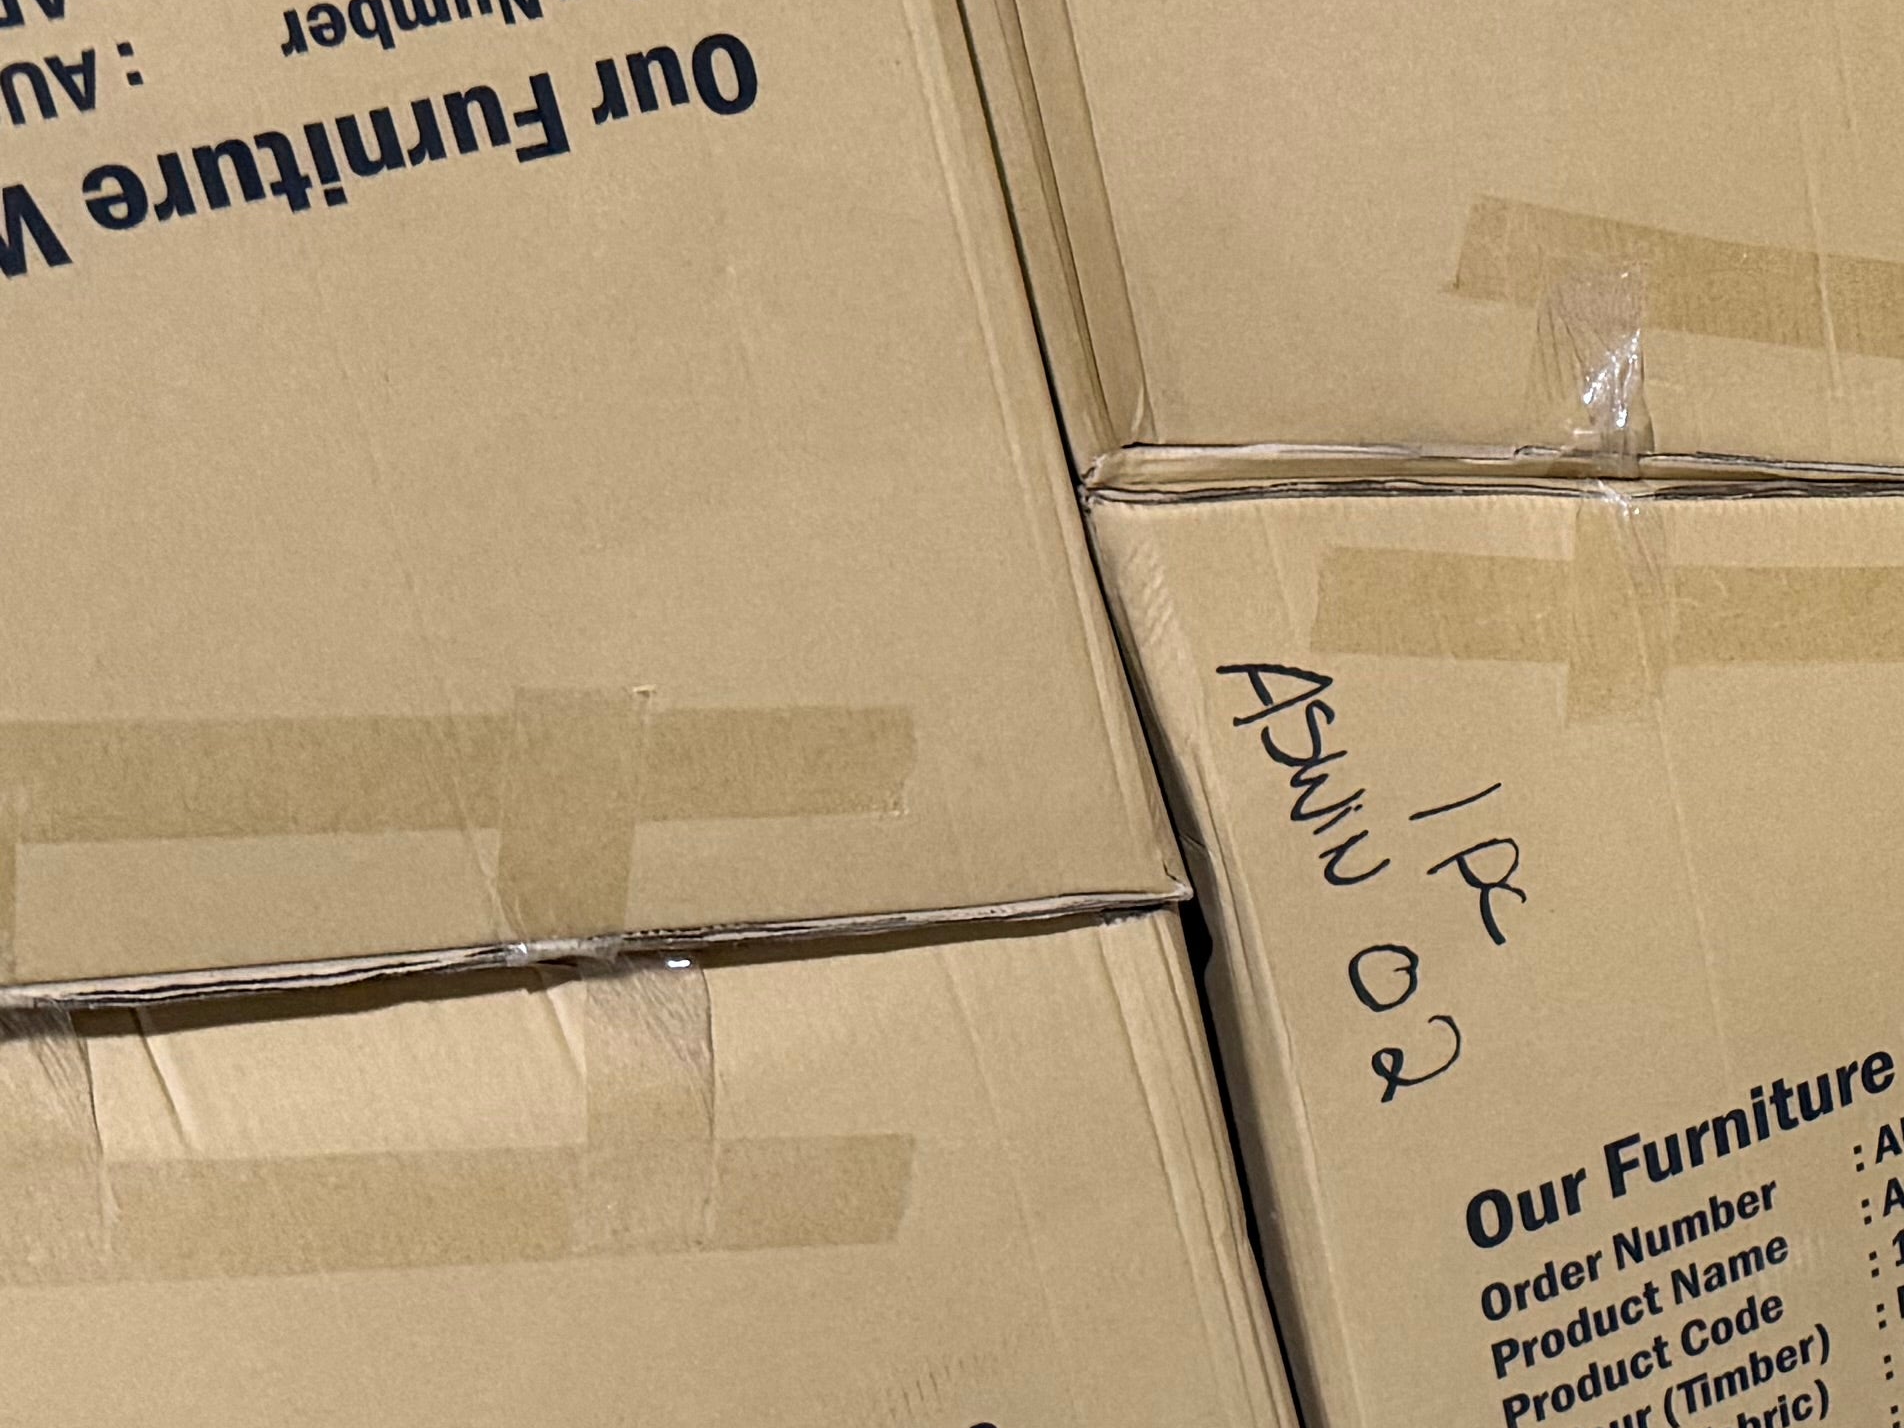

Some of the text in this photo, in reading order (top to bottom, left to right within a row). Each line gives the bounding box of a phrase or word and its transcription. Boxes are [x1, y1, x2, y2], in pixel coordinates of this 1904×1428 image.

[81, 71, 571, 231] Furniture
[591, 32, 759, 125] Our
[1347, 943, 1462, 1104] 02
[1465, 1167, 1587, 1249] Our
[1603, 1050, 1895, 1199] Furniture
[1480, 1250, 1603, 1322] Order
[1612, 1180, 1777, 1271] Number
[1680, 1295, 1784, 1357] Code
